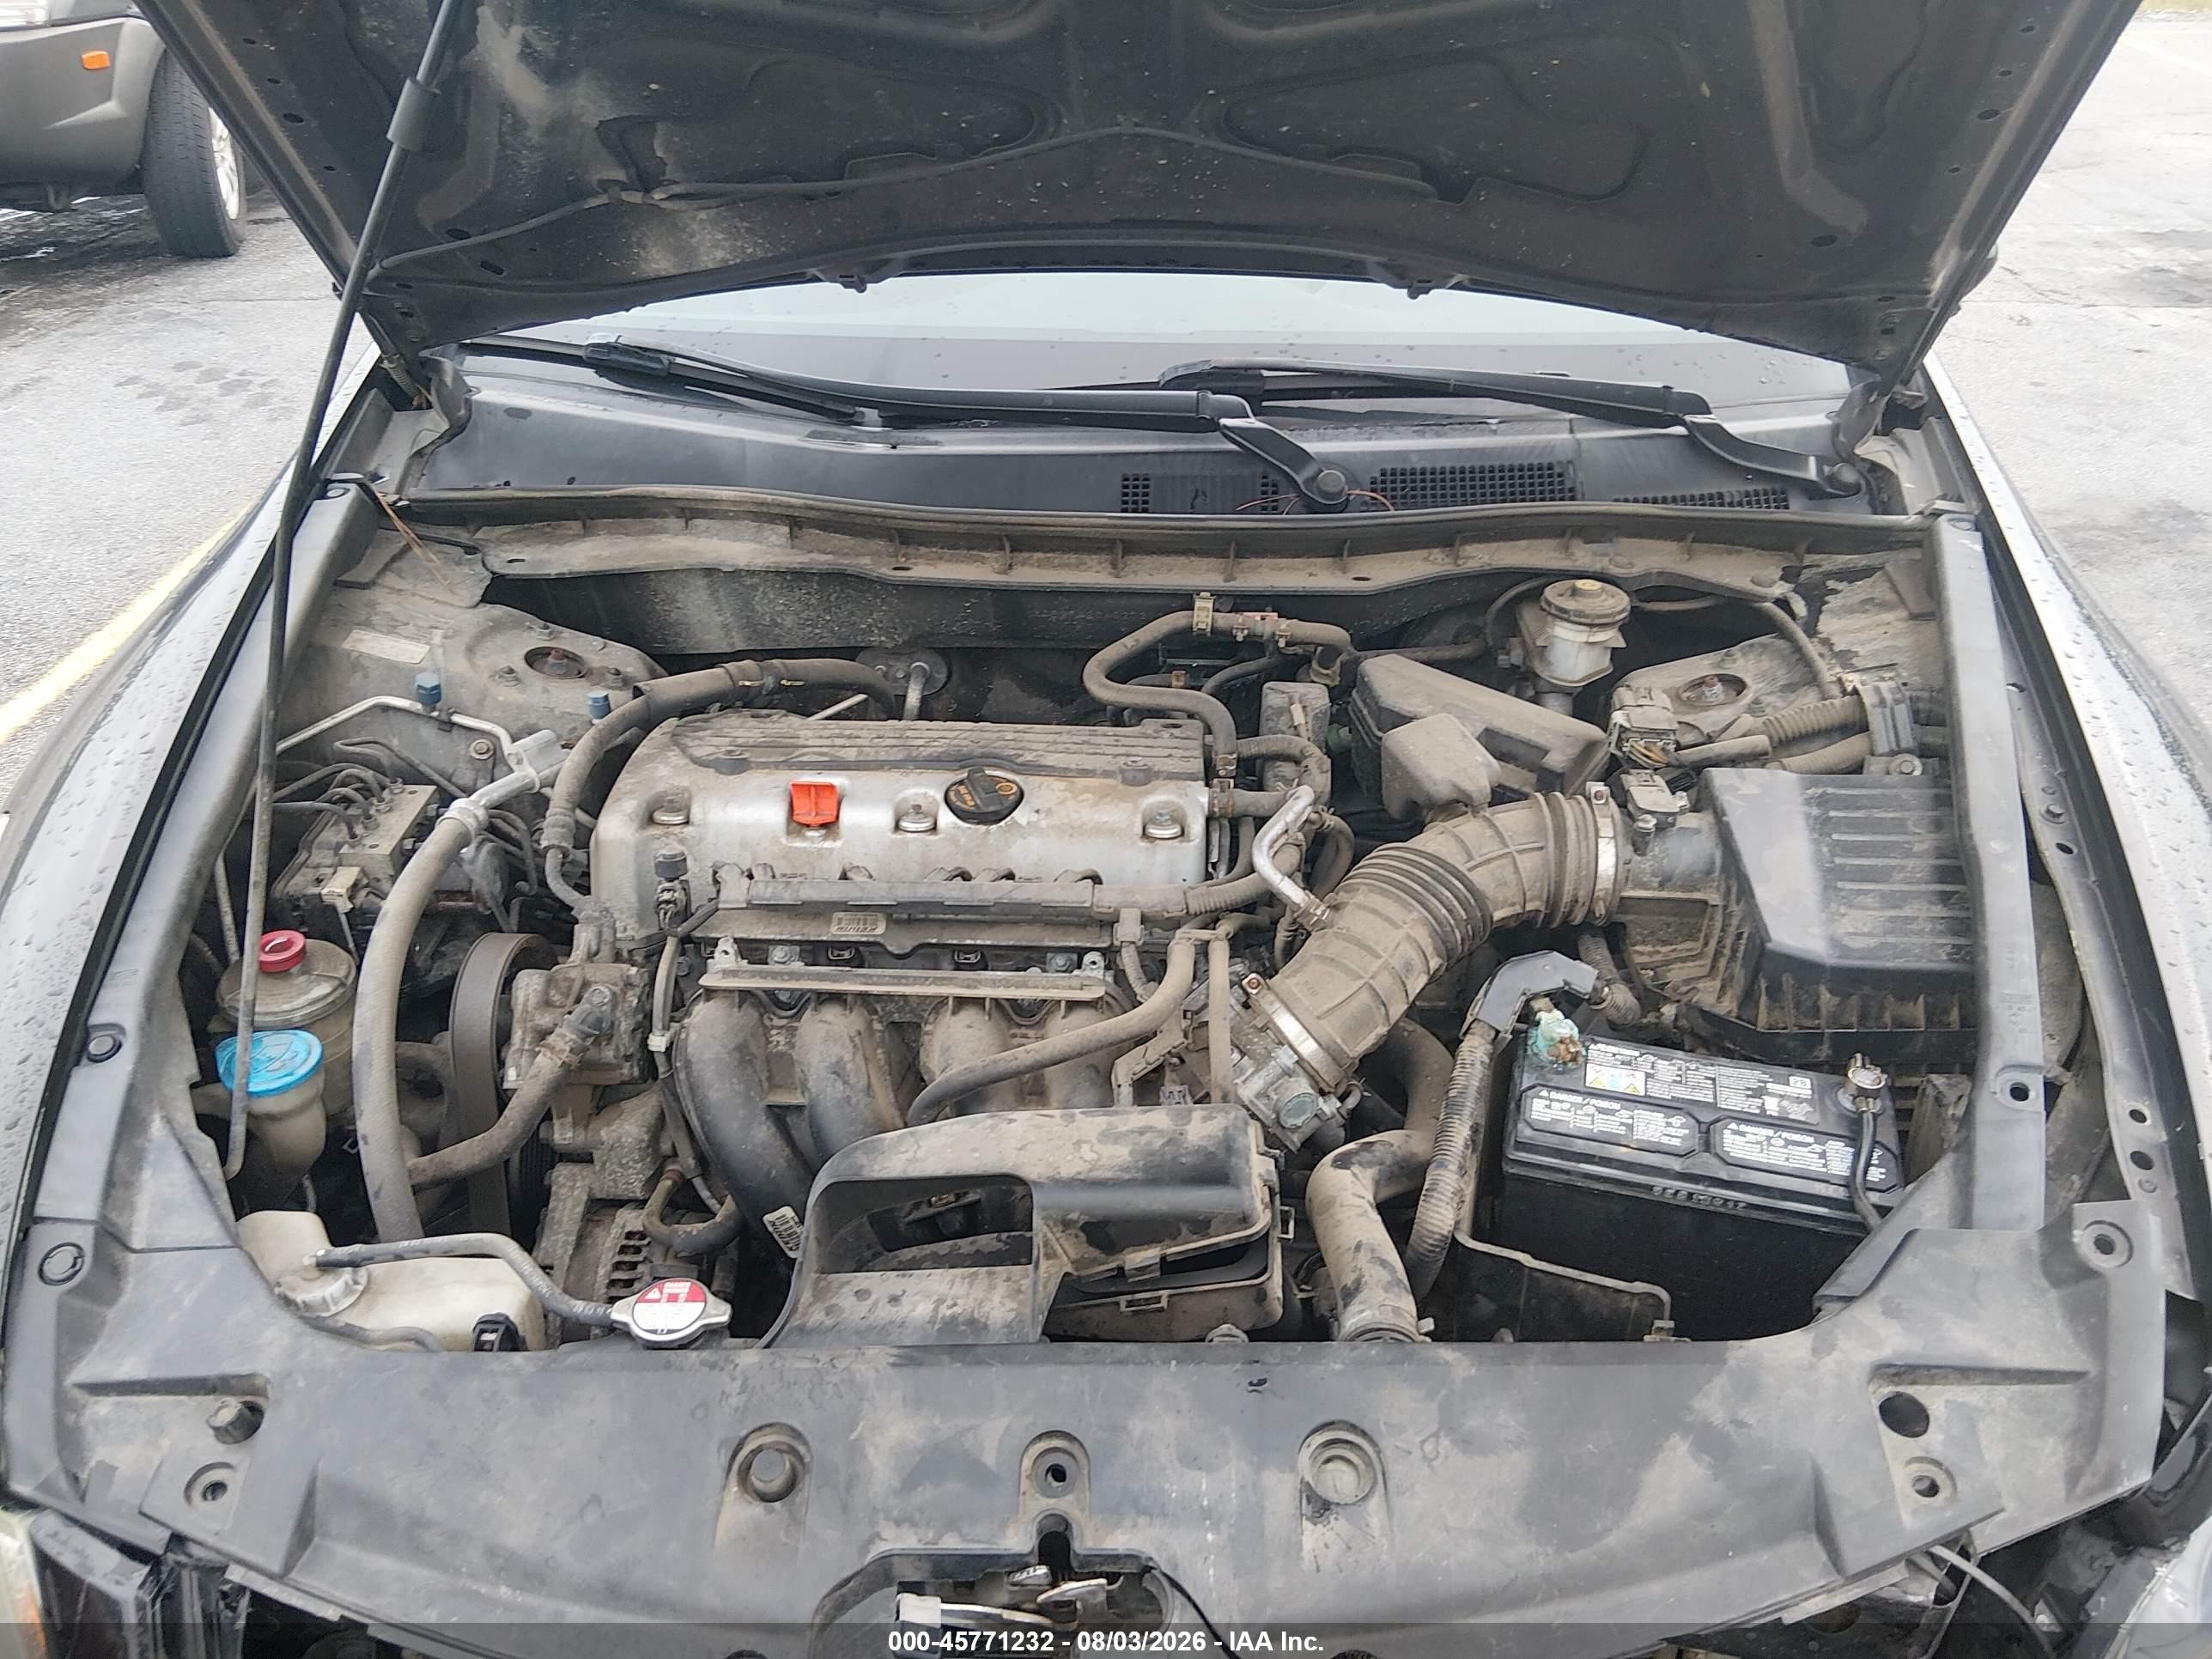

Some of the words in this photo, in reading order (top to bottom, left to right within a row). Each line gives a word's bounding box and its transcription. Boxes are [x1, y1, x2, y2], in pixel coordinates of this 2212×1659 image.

[1549, 1091, 1583, 1103] DANGER
[1589, 1098, 1621, 1110] POISON
[1781, 1132, 1814, 1144] POISON
